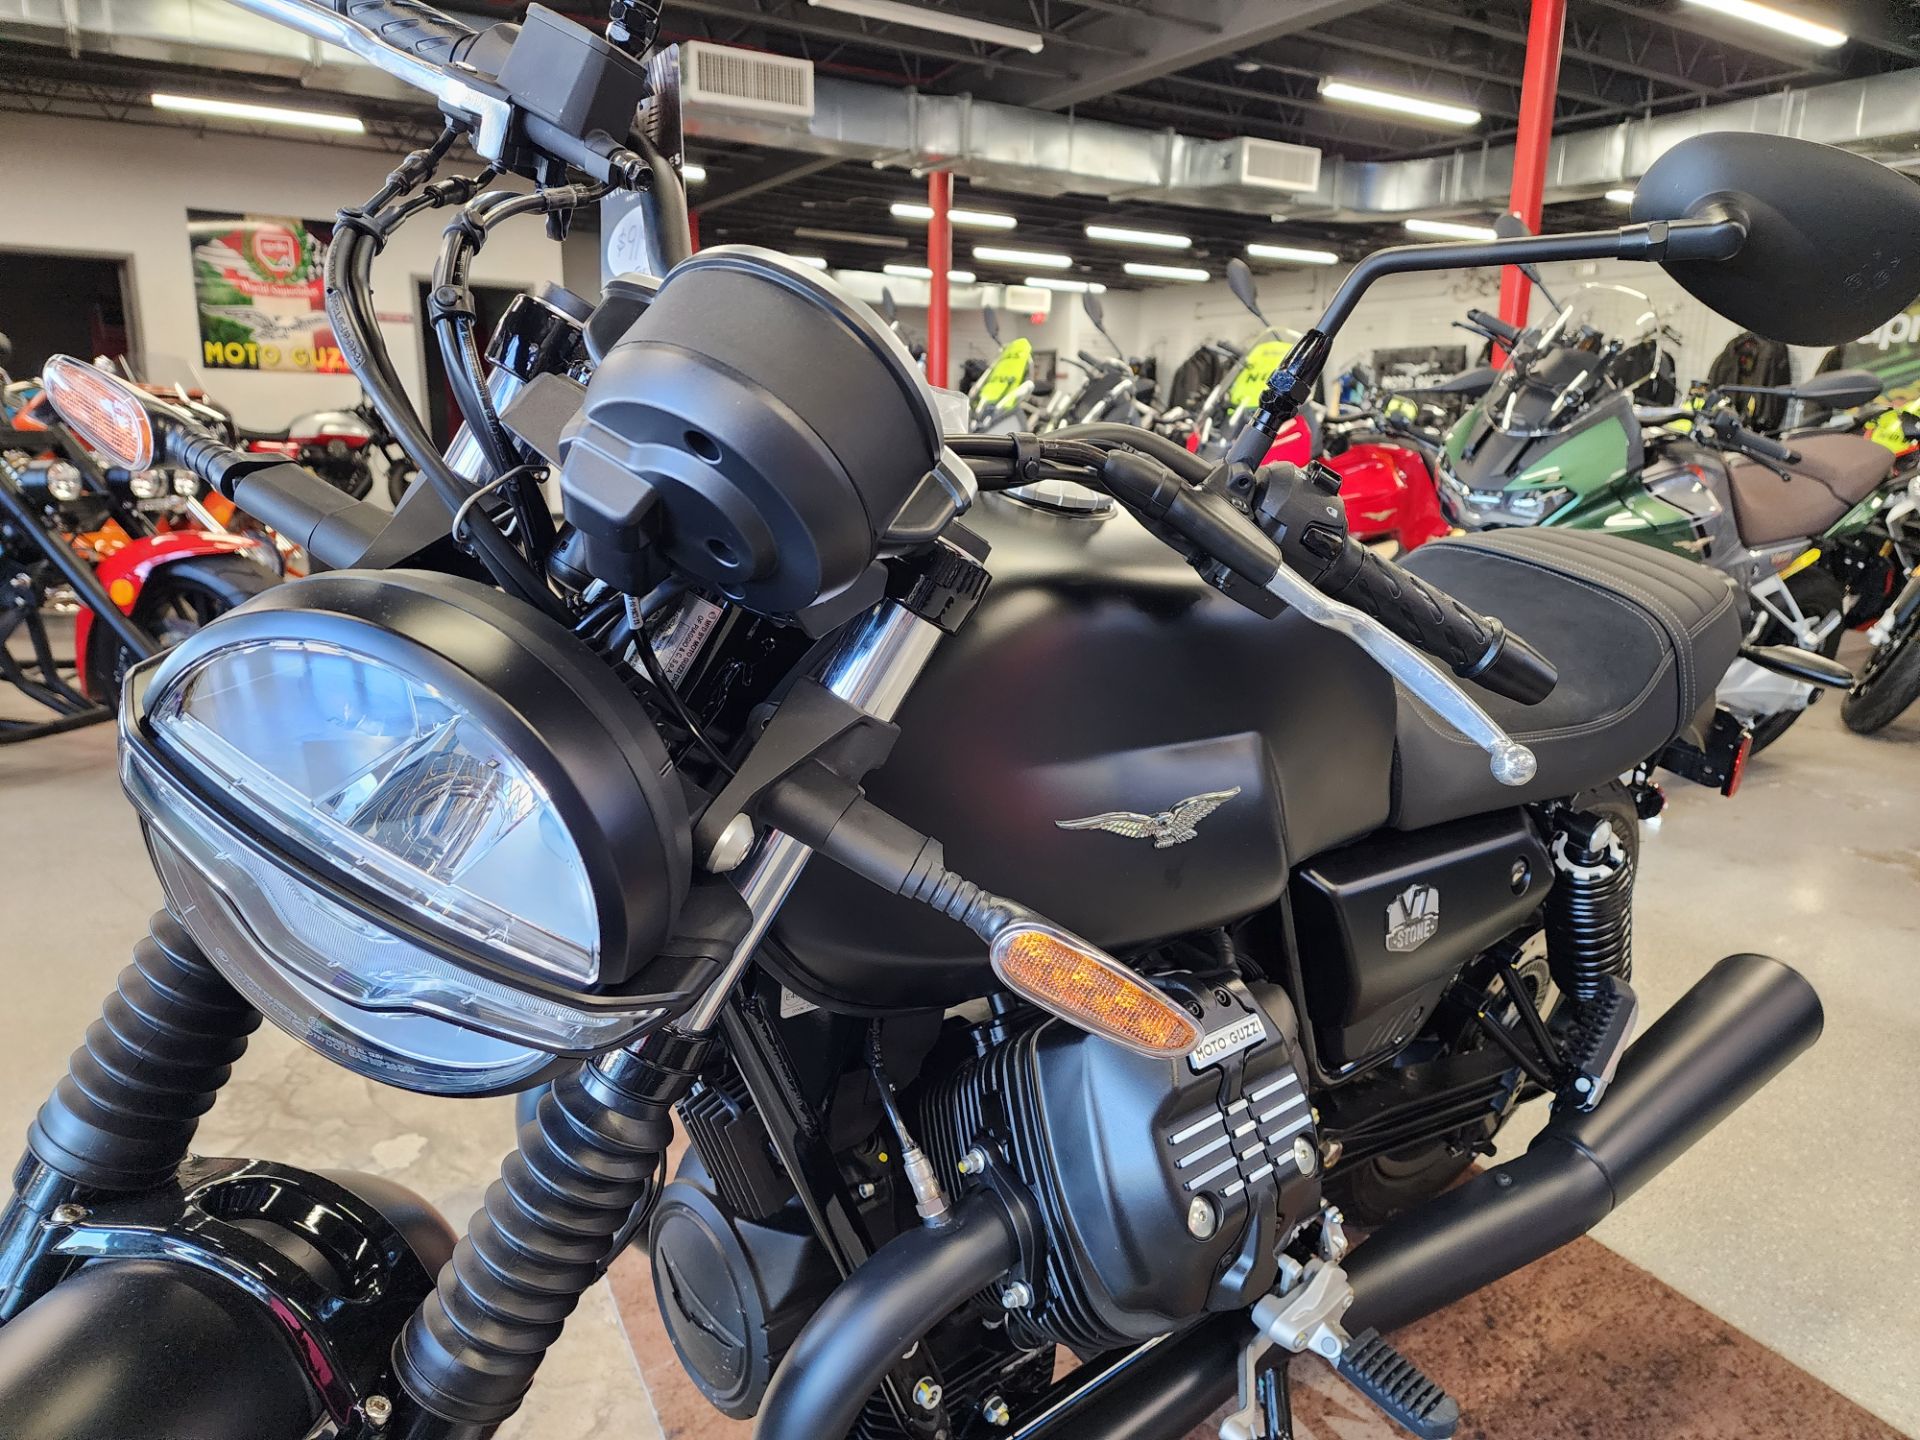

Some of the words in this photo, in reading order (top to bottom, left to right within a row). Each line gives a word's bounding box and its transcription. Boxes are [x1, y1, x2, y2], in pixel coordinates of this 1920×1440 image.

[204, 341, 281, 366] MOTO
[291, 345, 350, 369] GUZ
[696, 615, 704, 623] OF
[683, 623, 699, 648] PIAGGIO
[687, 639, 700, 657] MOTO
[677, 656, 691, 674] GUZZI
[1396, 919, 1432, 949] STONE
[1196, 1036, 1228, 1061] MOTO
[1229, 1019, 1262, 1045] GUZZI
